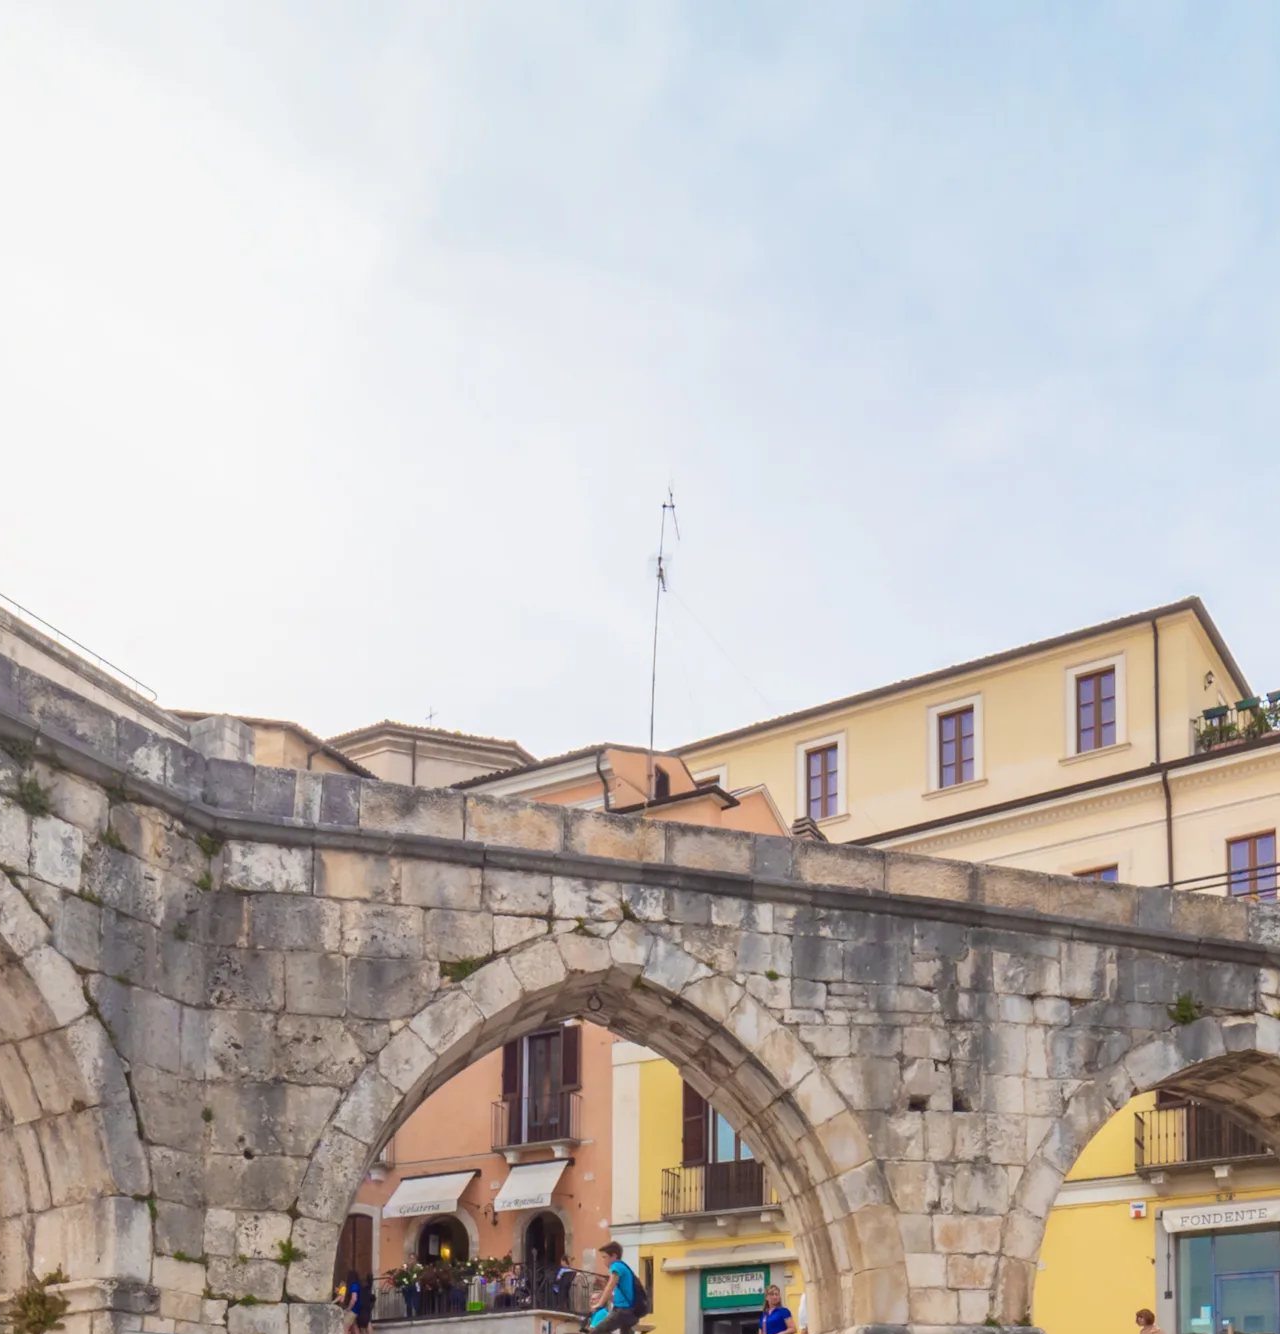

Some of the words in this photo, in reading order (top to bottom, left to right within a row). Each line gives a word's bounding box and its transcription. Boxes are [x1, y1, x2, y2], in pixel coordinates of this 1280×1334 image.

[514, 1196, 544, 1207] Rotonda
[399, 1204, 440, 1215] Gelateria
[1180, 1208, 1268, 1227] FONDENTE
[708, 1273, 764, 1285] ERBORISTERIA
